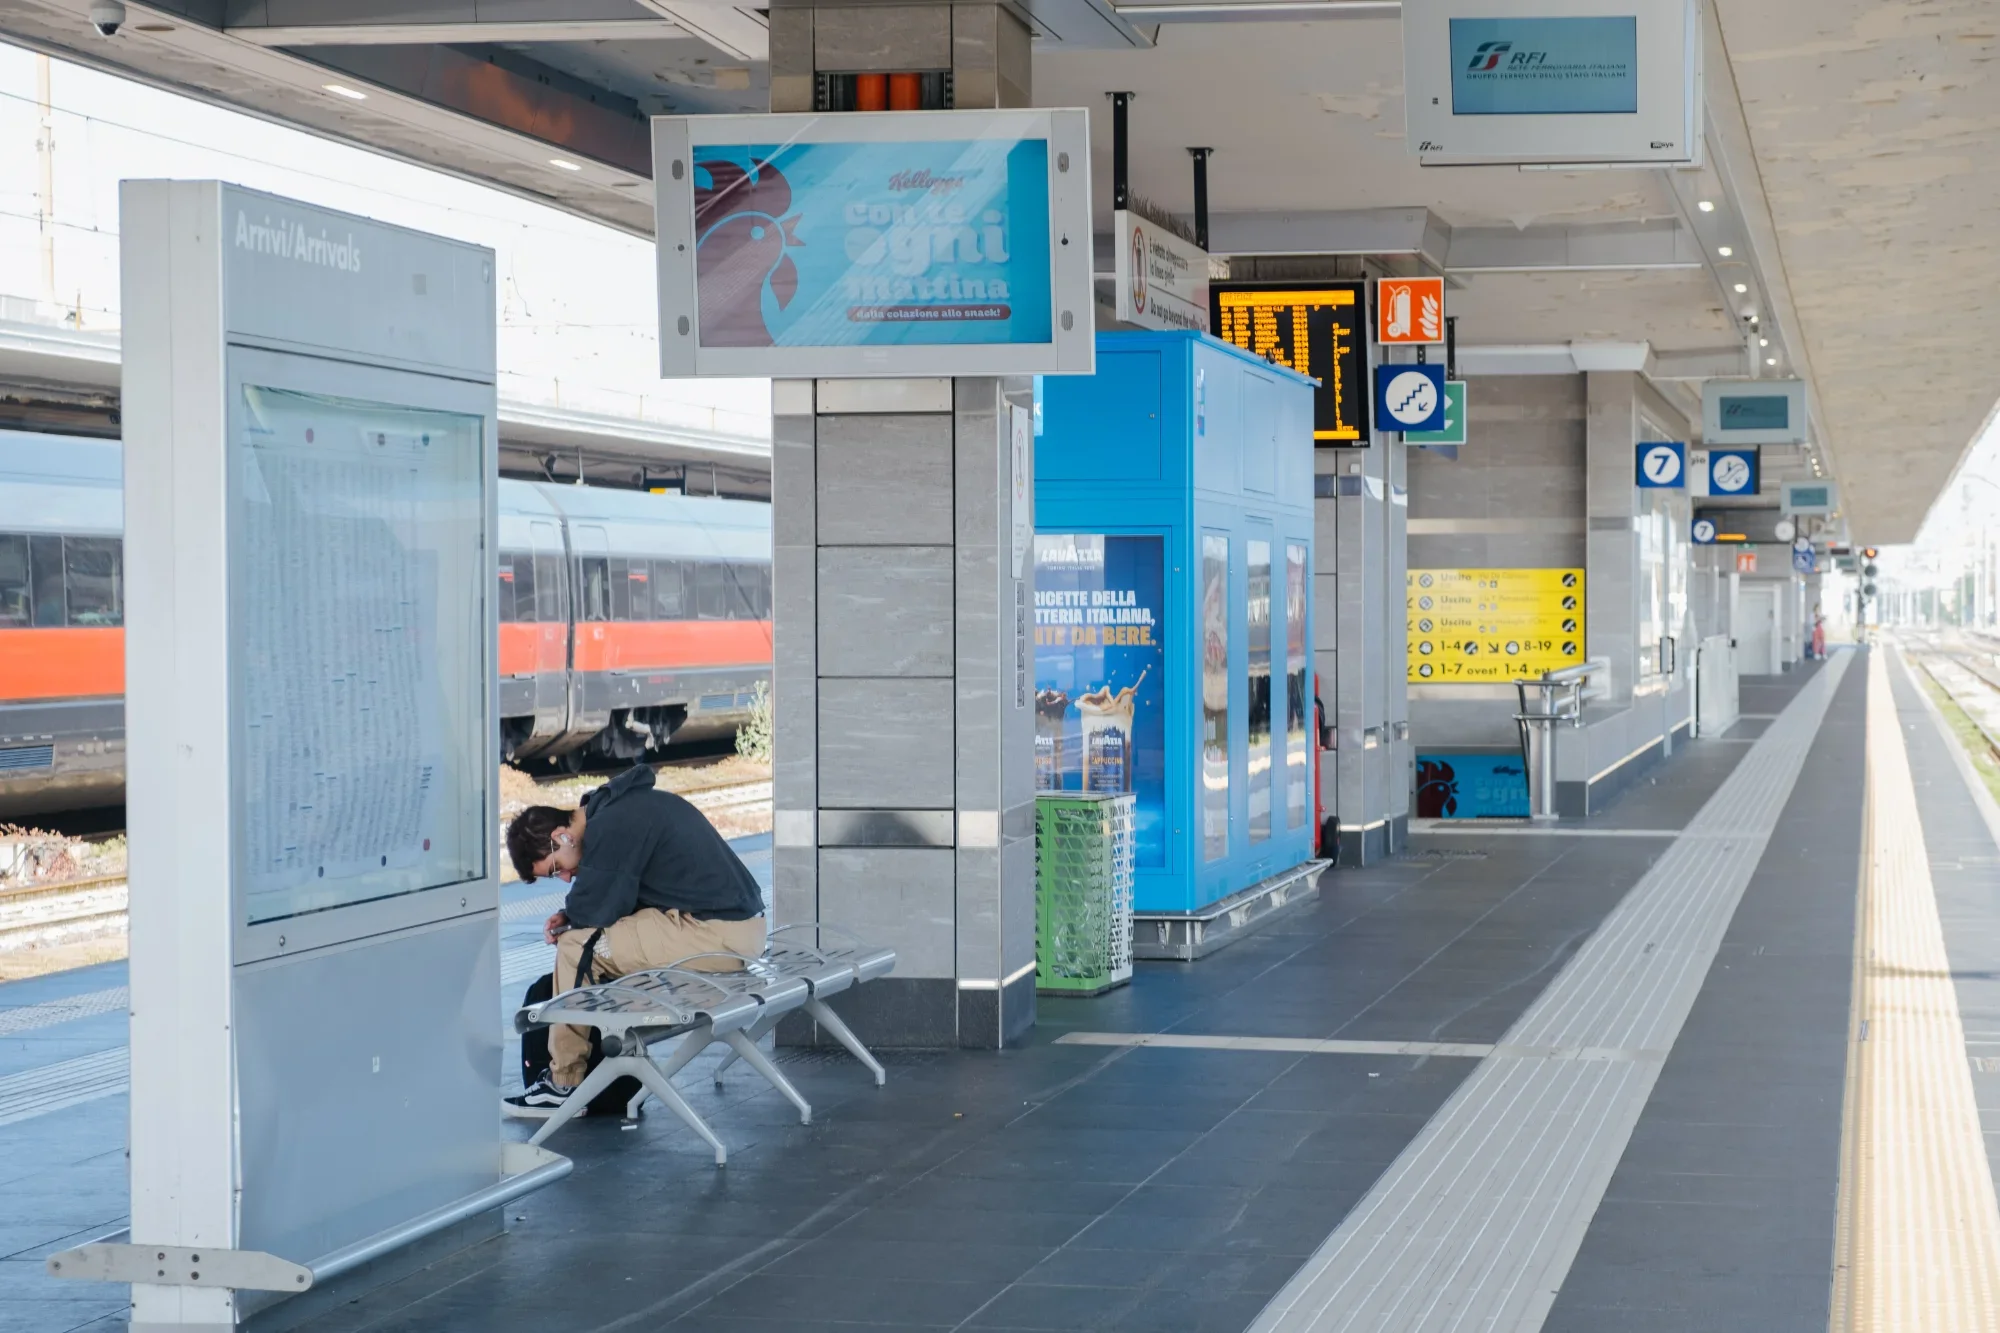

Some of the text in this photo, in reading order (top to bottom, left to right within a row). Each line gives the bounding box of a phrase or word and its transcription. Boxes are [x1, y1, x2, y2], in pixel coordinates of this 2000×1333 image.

[1510, 52, 1547, 64] RFI
[235, 209, 360, 273] Arrivi/Arrivals
[845, 210, 1010, 277] ogni
[847, 272, 1010, 300] mattina
[887, 308, 940, 319] colazione
[941, 307, 962, 318] allo
[964, 306, 1001, 318] snack!
[1654, 455, 1671, 476] 7
[1700, 525, 1710, 537] 7
[1041, 544, 1103, 563] LAVAZZA
[1091, 590, 1137, 607] DELLA
[1440, 595, 1472, 603] Uscita
[1086, 608, 1156, 627] ITALIANA,
[1440, 617, 1472, 627] Uscita
[1071, 626, 1097, 646] DA
[1102, 626, 1157, 646] BERE.
[1441, 640, 1552, 651] 1-4 8-19
[1441, 663, 1463, 675] 1-7
[1466, 667, 1498, 675] ovest
[1504, 663, 1528, 675] 1-4
